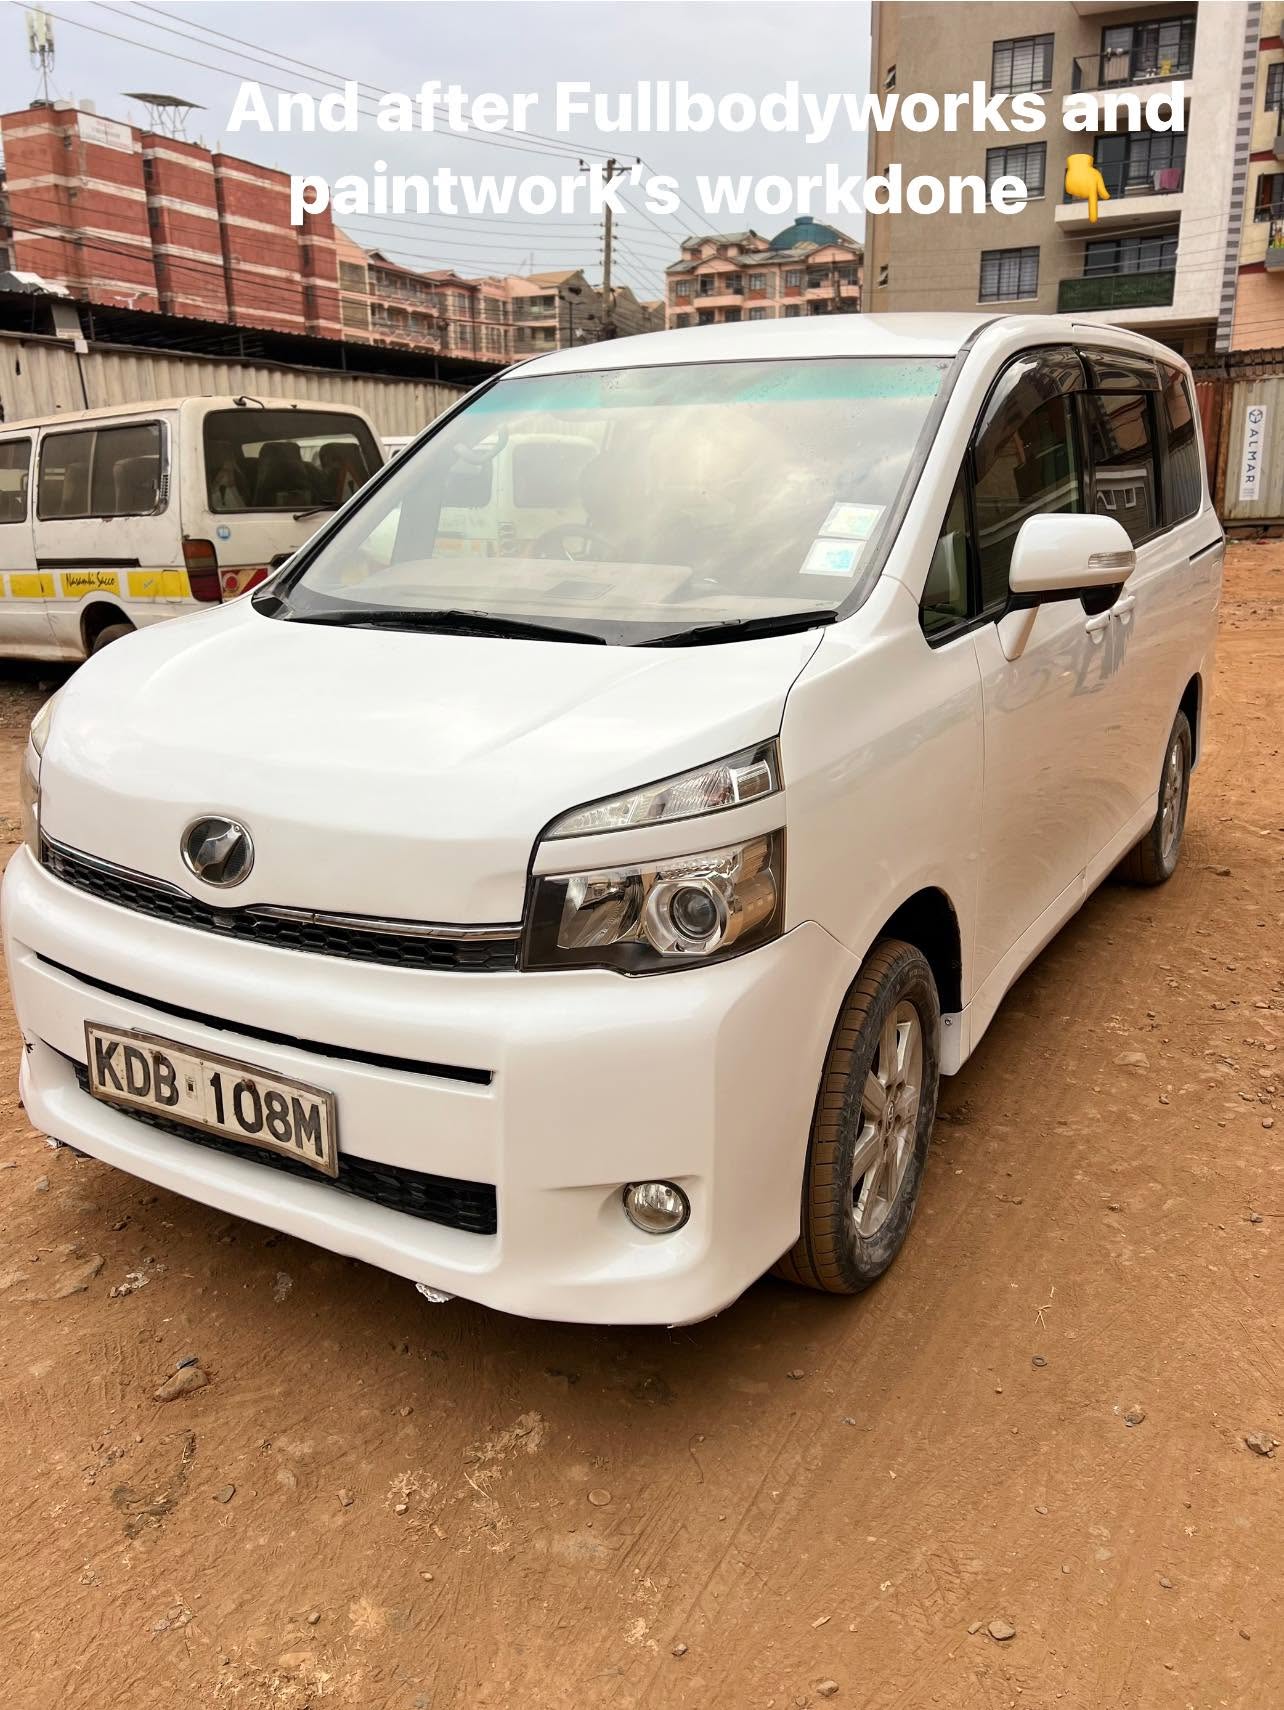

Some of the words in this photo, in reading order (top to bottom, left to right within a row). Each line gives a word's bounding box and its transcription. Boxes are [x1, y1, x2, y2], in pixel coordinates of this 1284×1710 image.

[1245, 428, 1259, 483] ALMAR
[94, 1037, 180, 1107] KDB
[209, 1071, 324, 1159] 108M
